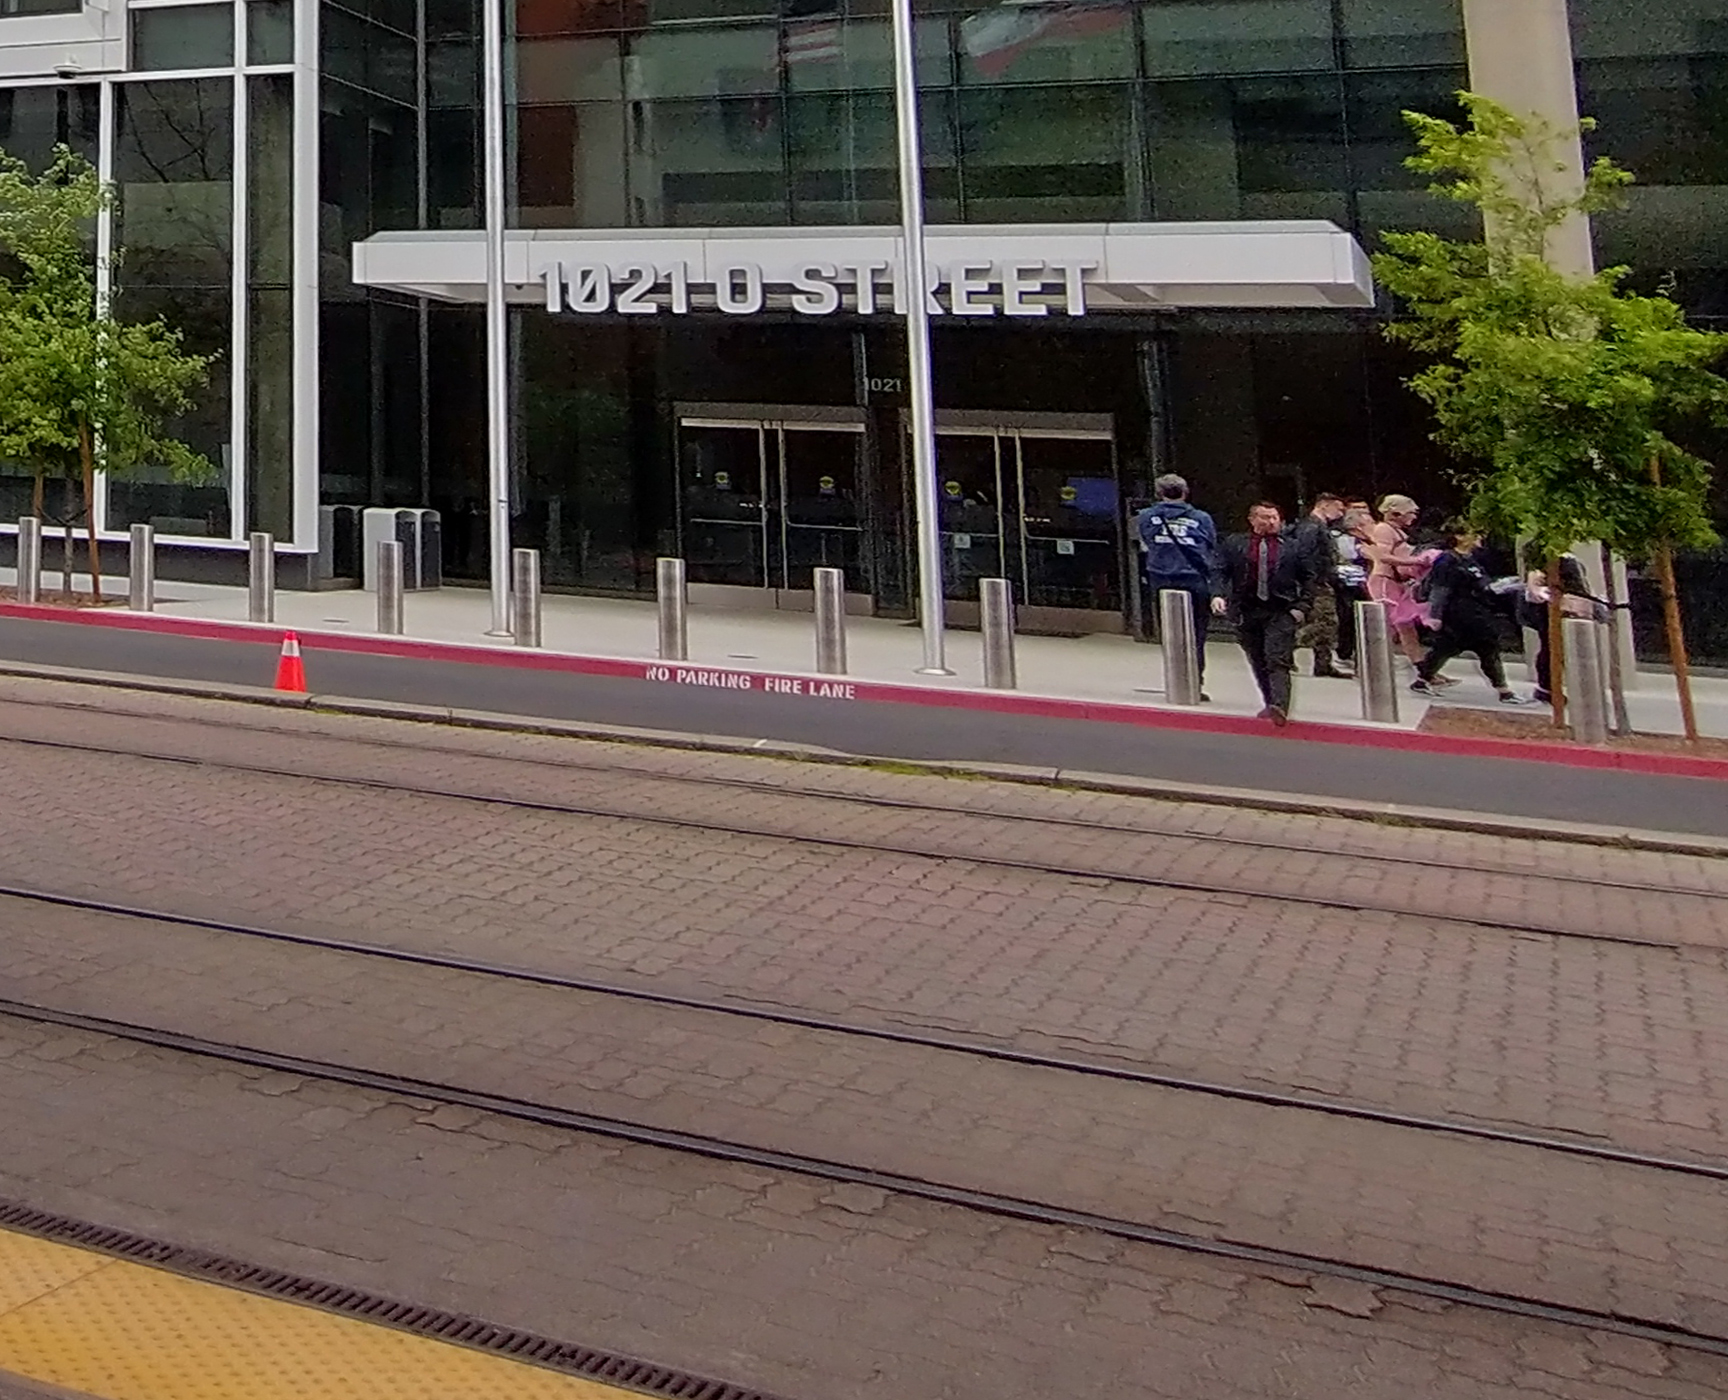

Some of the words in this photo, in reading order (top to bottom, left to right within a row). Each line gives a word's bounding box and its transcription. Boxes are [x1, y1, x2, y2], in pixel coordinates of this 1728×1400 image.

[540, 261, 690, 314] 1021
[715, 261, 765, 314] O
[790, 259, 1098, 316] STREET
[862, 377, 903, 392] 1021
[646, 665, 670, 681] NO
[676, 669, 752, 690] PARKING
[765, 677, 802, 695] FIRE
[809, 681, 856, 700] LANE
